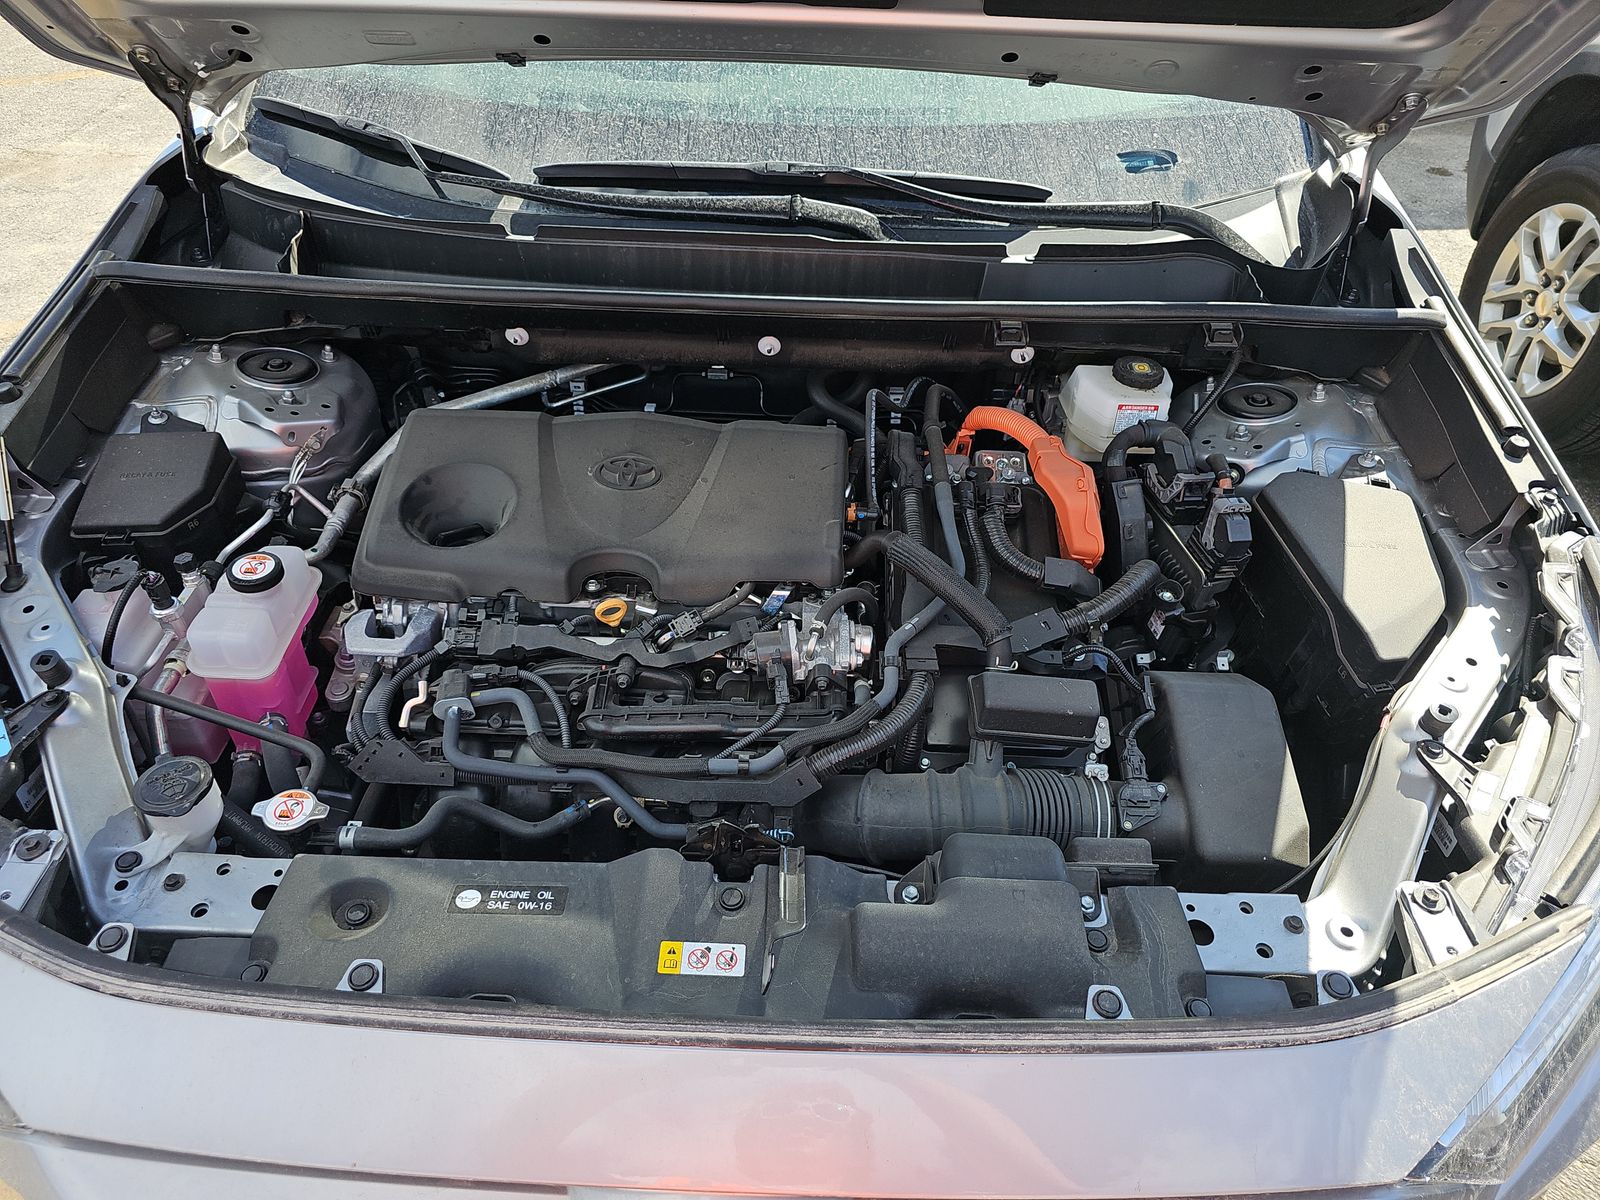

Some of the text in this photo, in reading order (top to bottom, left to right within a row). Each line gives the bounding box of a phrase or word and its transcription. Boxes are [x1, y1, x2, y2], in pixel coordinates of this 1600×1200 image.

[187, 519, 199, 530] R6
[256, 832, 286, 856] NICHIRIN
[490, 891, 554, 899] ENGINE OIL
[487, 901, 552, 910] SAE 0W-16
